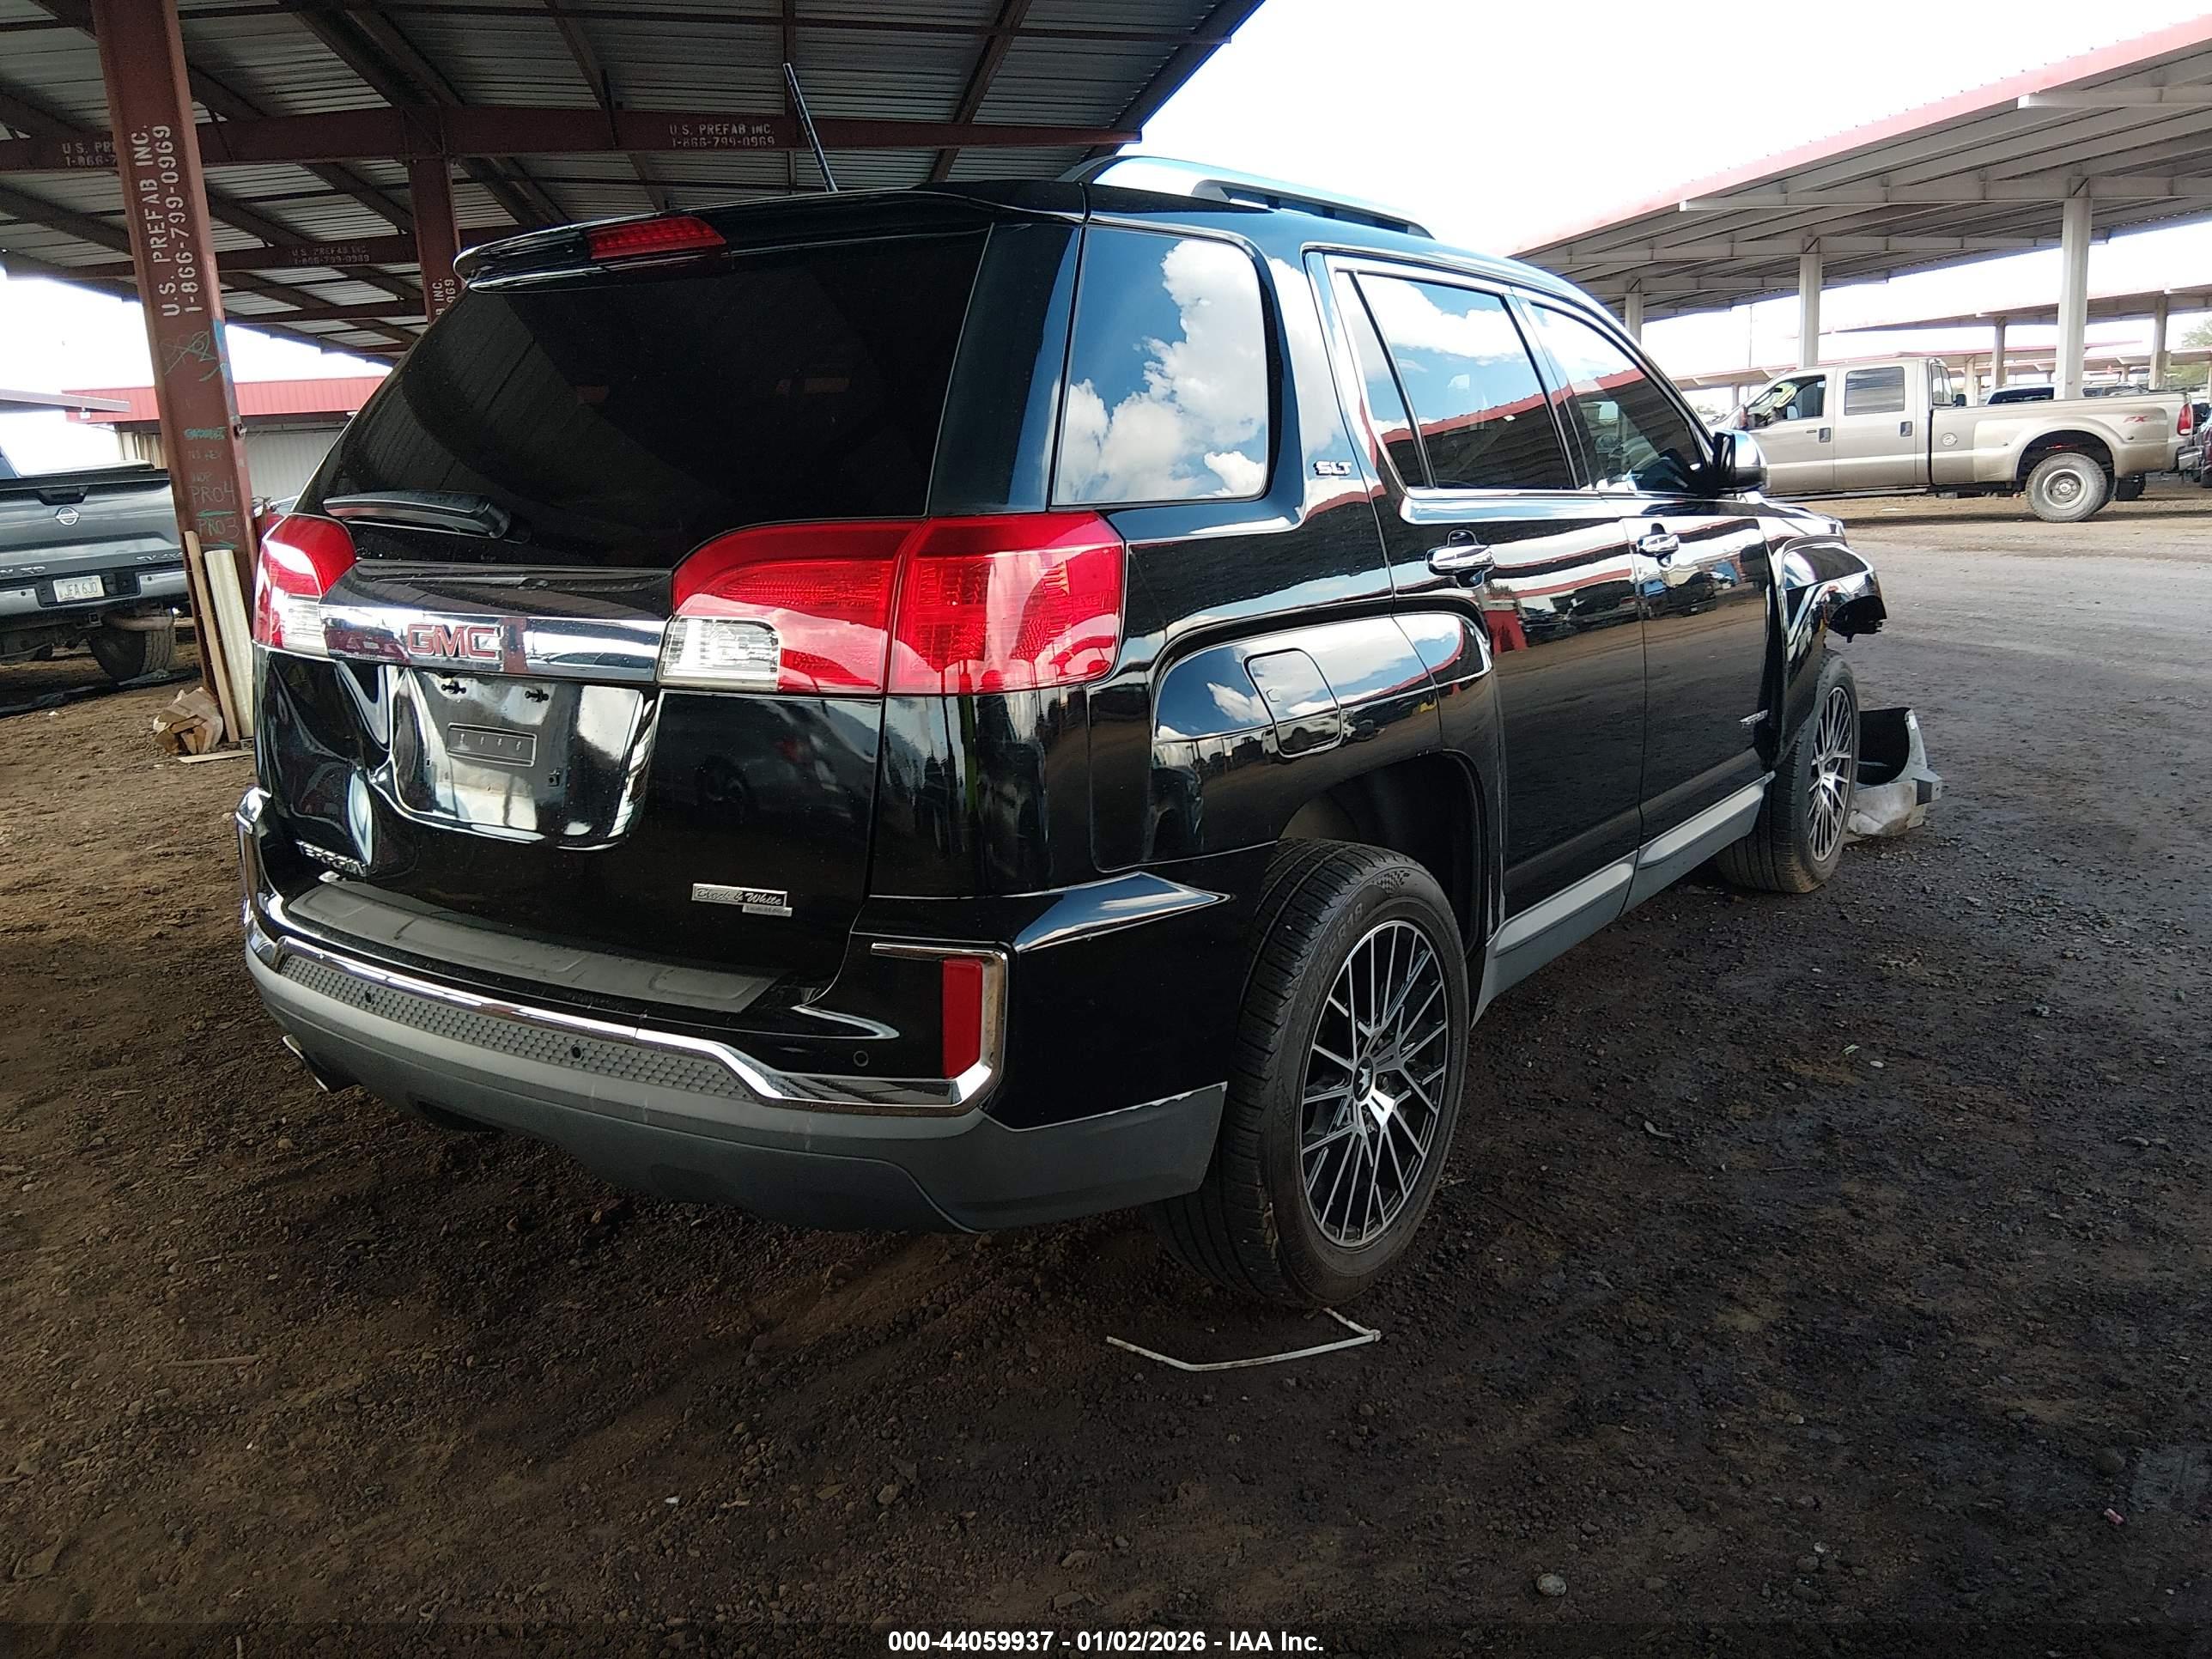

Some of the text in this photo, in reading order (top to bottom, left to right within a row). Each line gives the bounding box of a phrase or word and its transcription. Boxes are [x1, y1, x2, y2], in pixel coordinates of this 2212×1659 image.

[699, 124, 746, 135] PREFAB
[131, 125, 181, 317] U.S. PREFAB INC.
[152, 125, 203, 313] 1-866-799-0969
[432, 278, 445, 301] INC.
[1313, 460, 1352, 476] SLT
[406, 623, 501, 660] GMC
[744, 891, 783, 905] White
